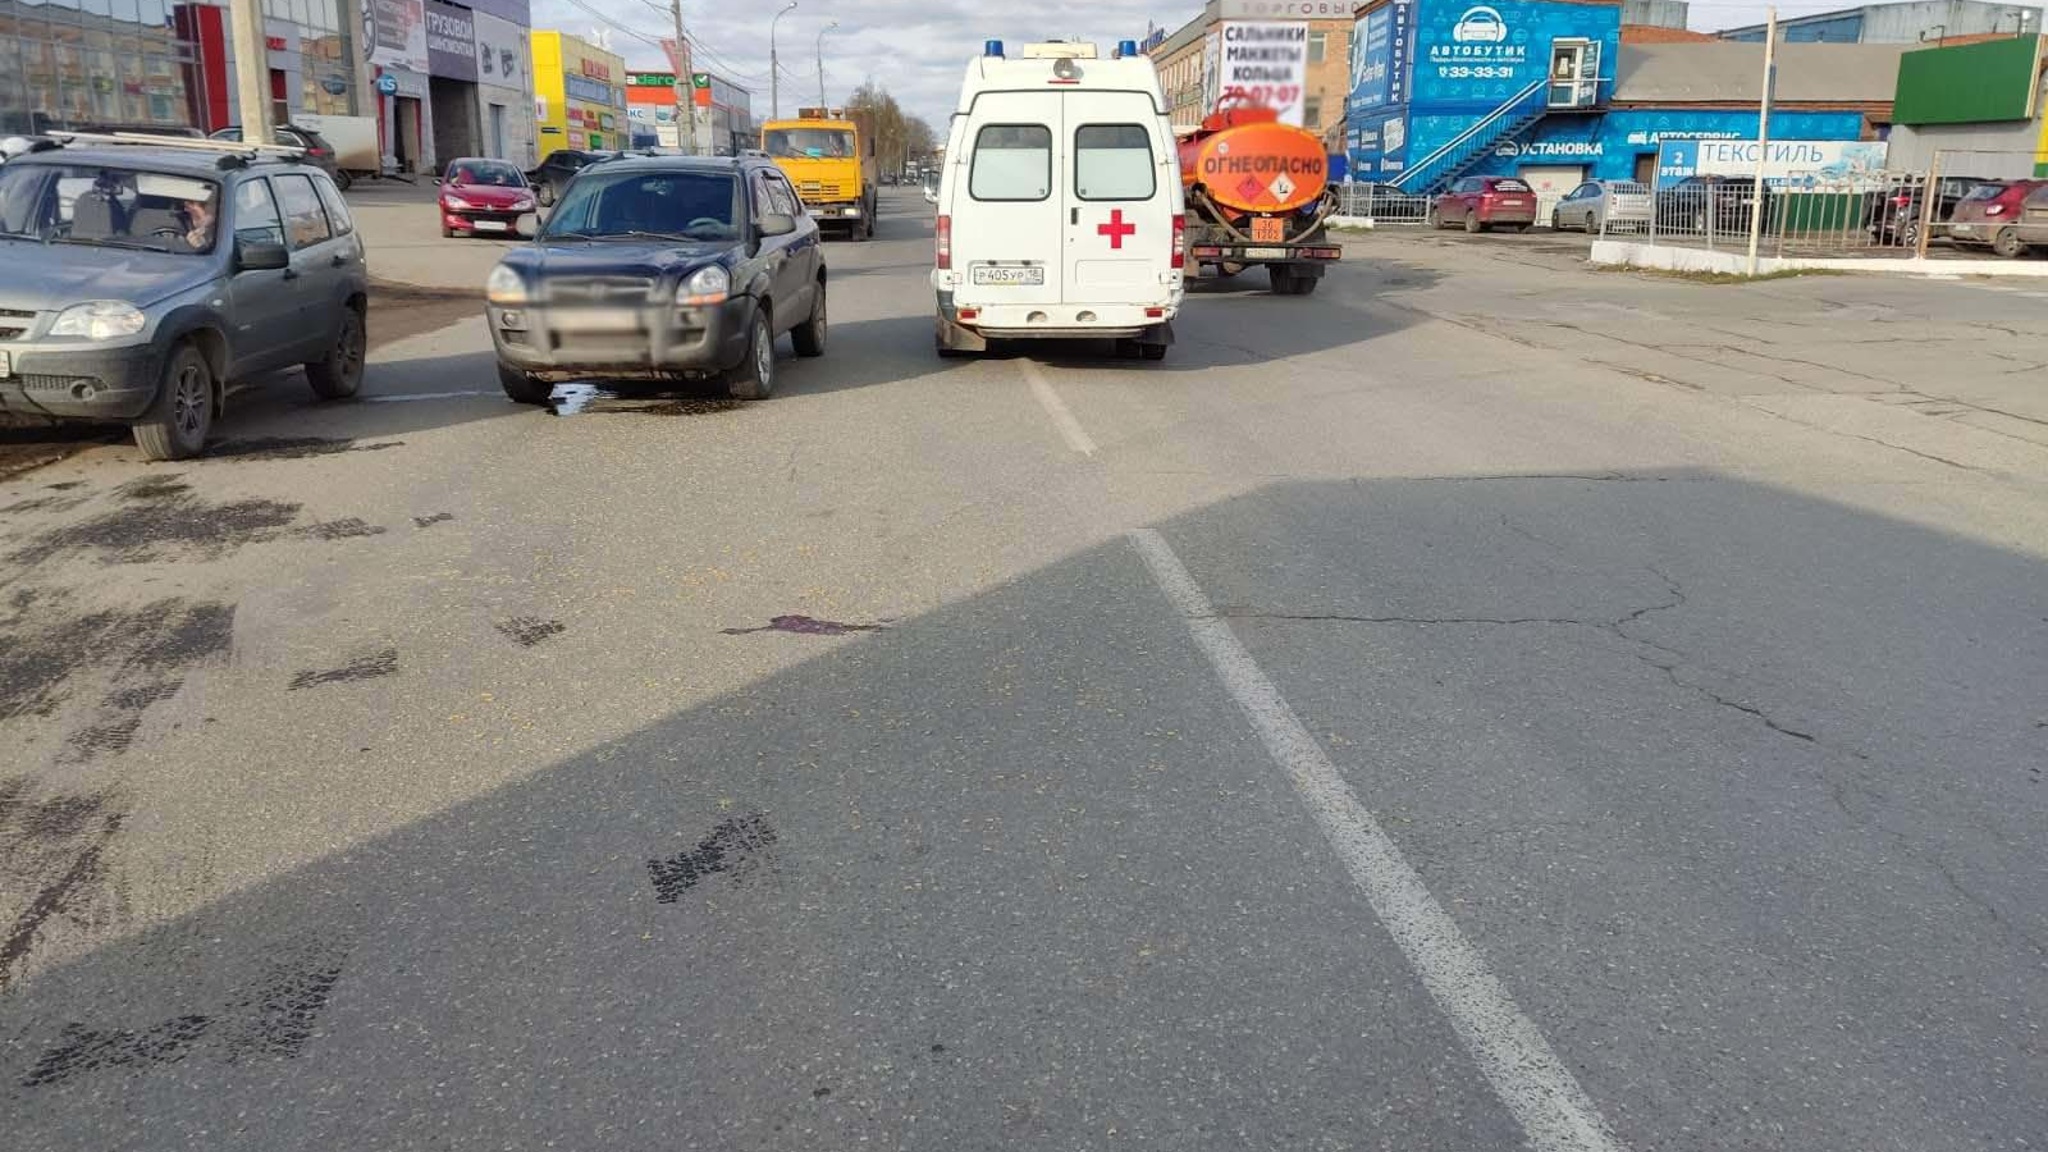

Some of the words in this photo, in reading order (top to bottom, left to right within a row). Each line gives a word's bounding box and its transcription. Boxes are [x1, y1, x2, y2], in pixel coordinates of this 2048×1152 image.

[426, 11, 473, 41] ГРУЗОВОЙ
[1225, 26, 1306, 41] САЛЬНИКИ
[1227, 46, 1302, 61] МАНЖЕТЫ
[1391, 4, 1405, 102] АВТОБУТИК
[1430, 45, 1526, 56] АВТОБУТИК
[1232, 66, 1292, 81] КОЛЬЦА
[1449, 66, 1514, 78] 33-33-31
[1521, 143, 1603, 156] УСТАНОВКА
[1703, 143, 1824, 163] ТЕКСТИЛЬ
[1204, 156, 1323, 174] ОГНЕОПАСНО
[1673, 152, 1683, 165] 2
